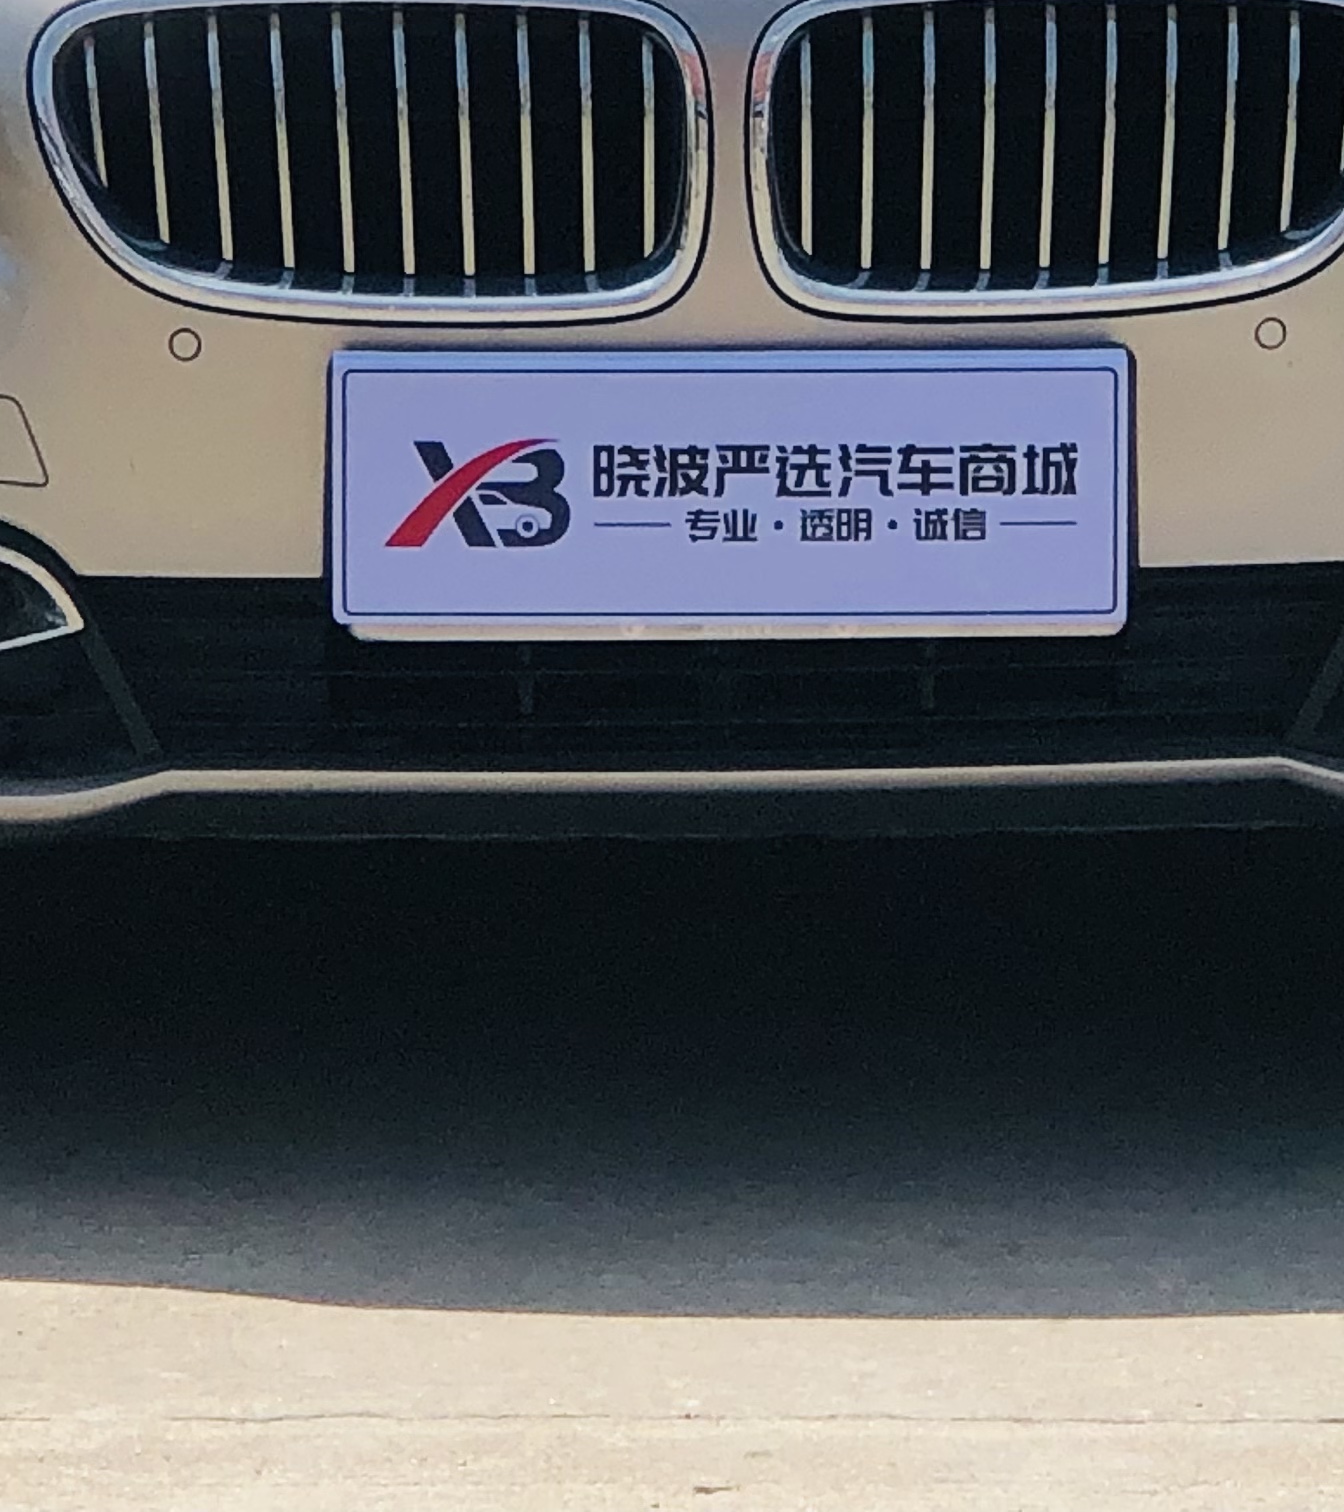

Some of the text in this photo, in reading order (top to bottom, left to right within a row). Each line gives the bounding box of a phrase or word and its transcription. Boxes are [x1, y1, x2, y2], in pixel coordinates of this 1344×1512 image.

[593, 442, 1078, 498] 晓波严选汽车商城
